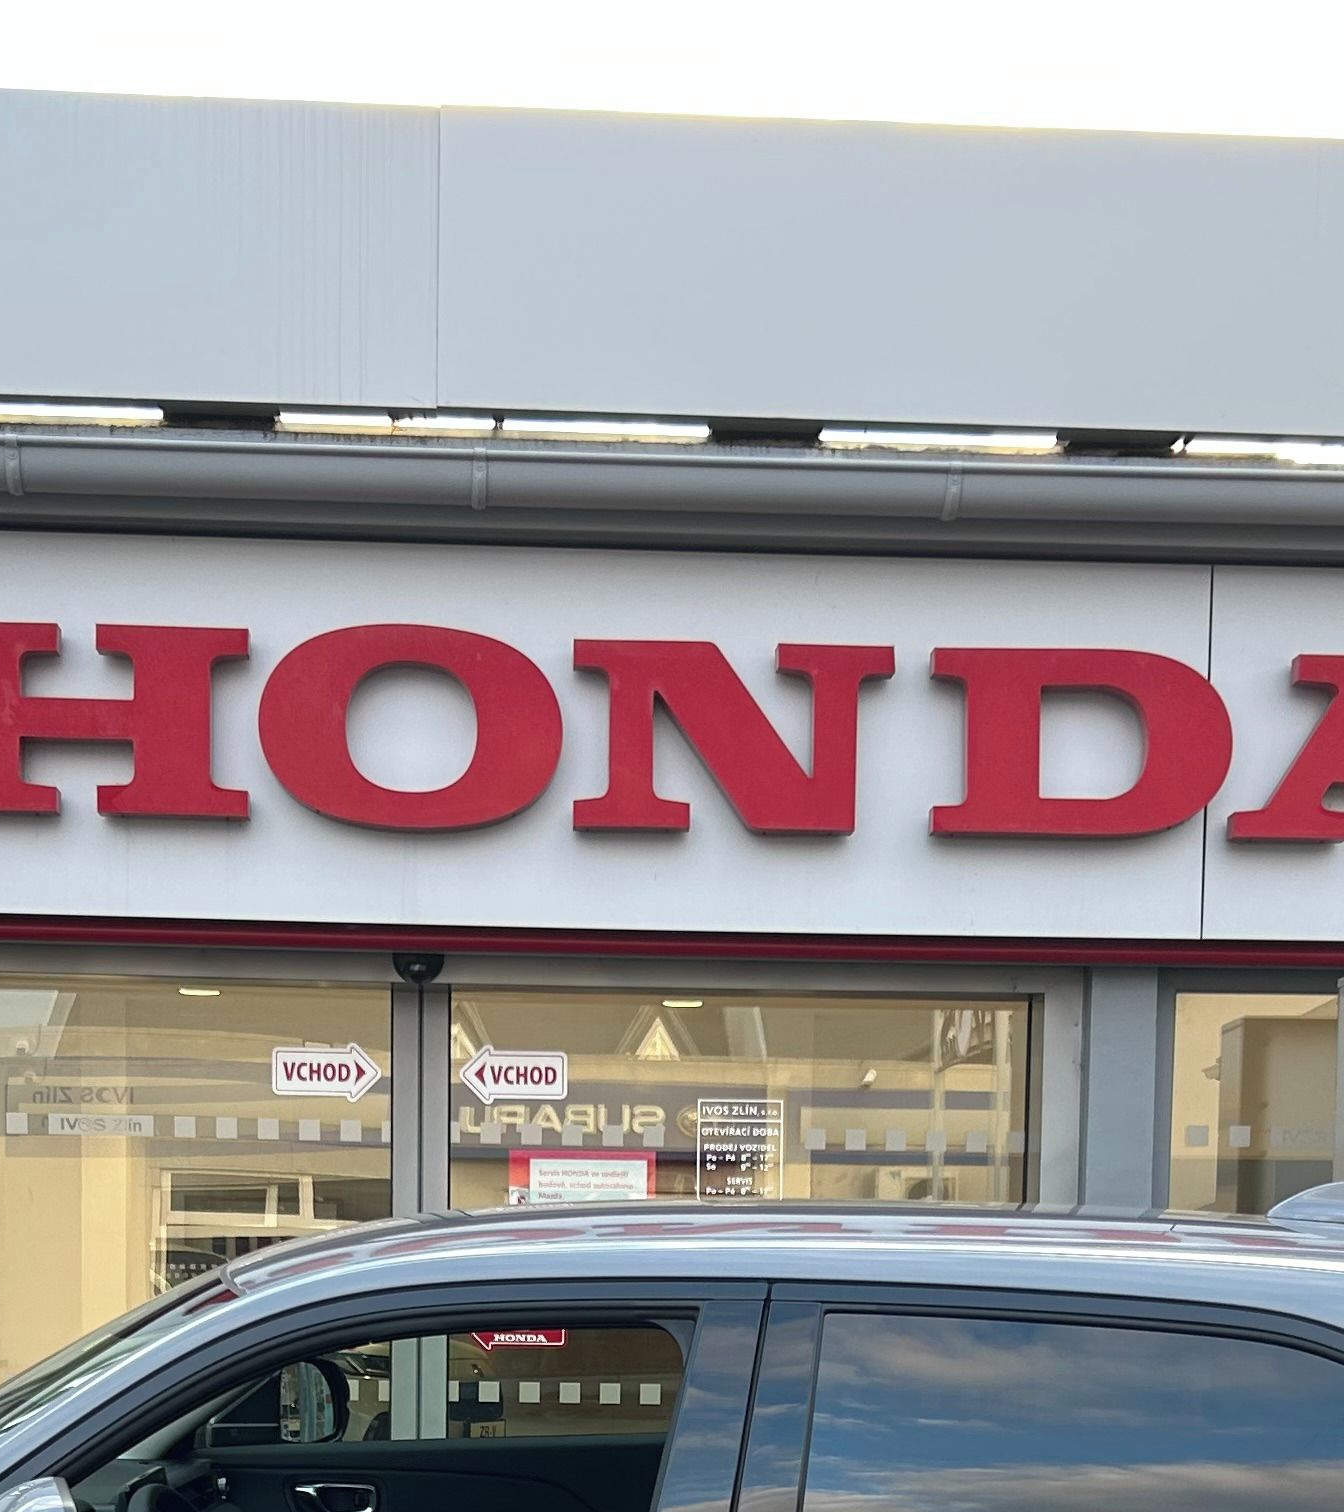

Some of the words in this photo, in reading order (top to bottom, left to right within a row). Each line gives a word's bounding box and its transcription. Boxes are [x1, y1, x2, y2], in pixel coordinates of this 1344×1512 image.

[283, 1061, 351, 1082] VCHOD
[490, 1065, 558, 1086] VCHOD
[702, 1105, 729, 1116] IVOS
[701, 1126, 751, 1136] OTEVÍRACÍ
[752, 1128, 779, 1136] DOBA
[493, 1334, 547, 1343] HONDA
